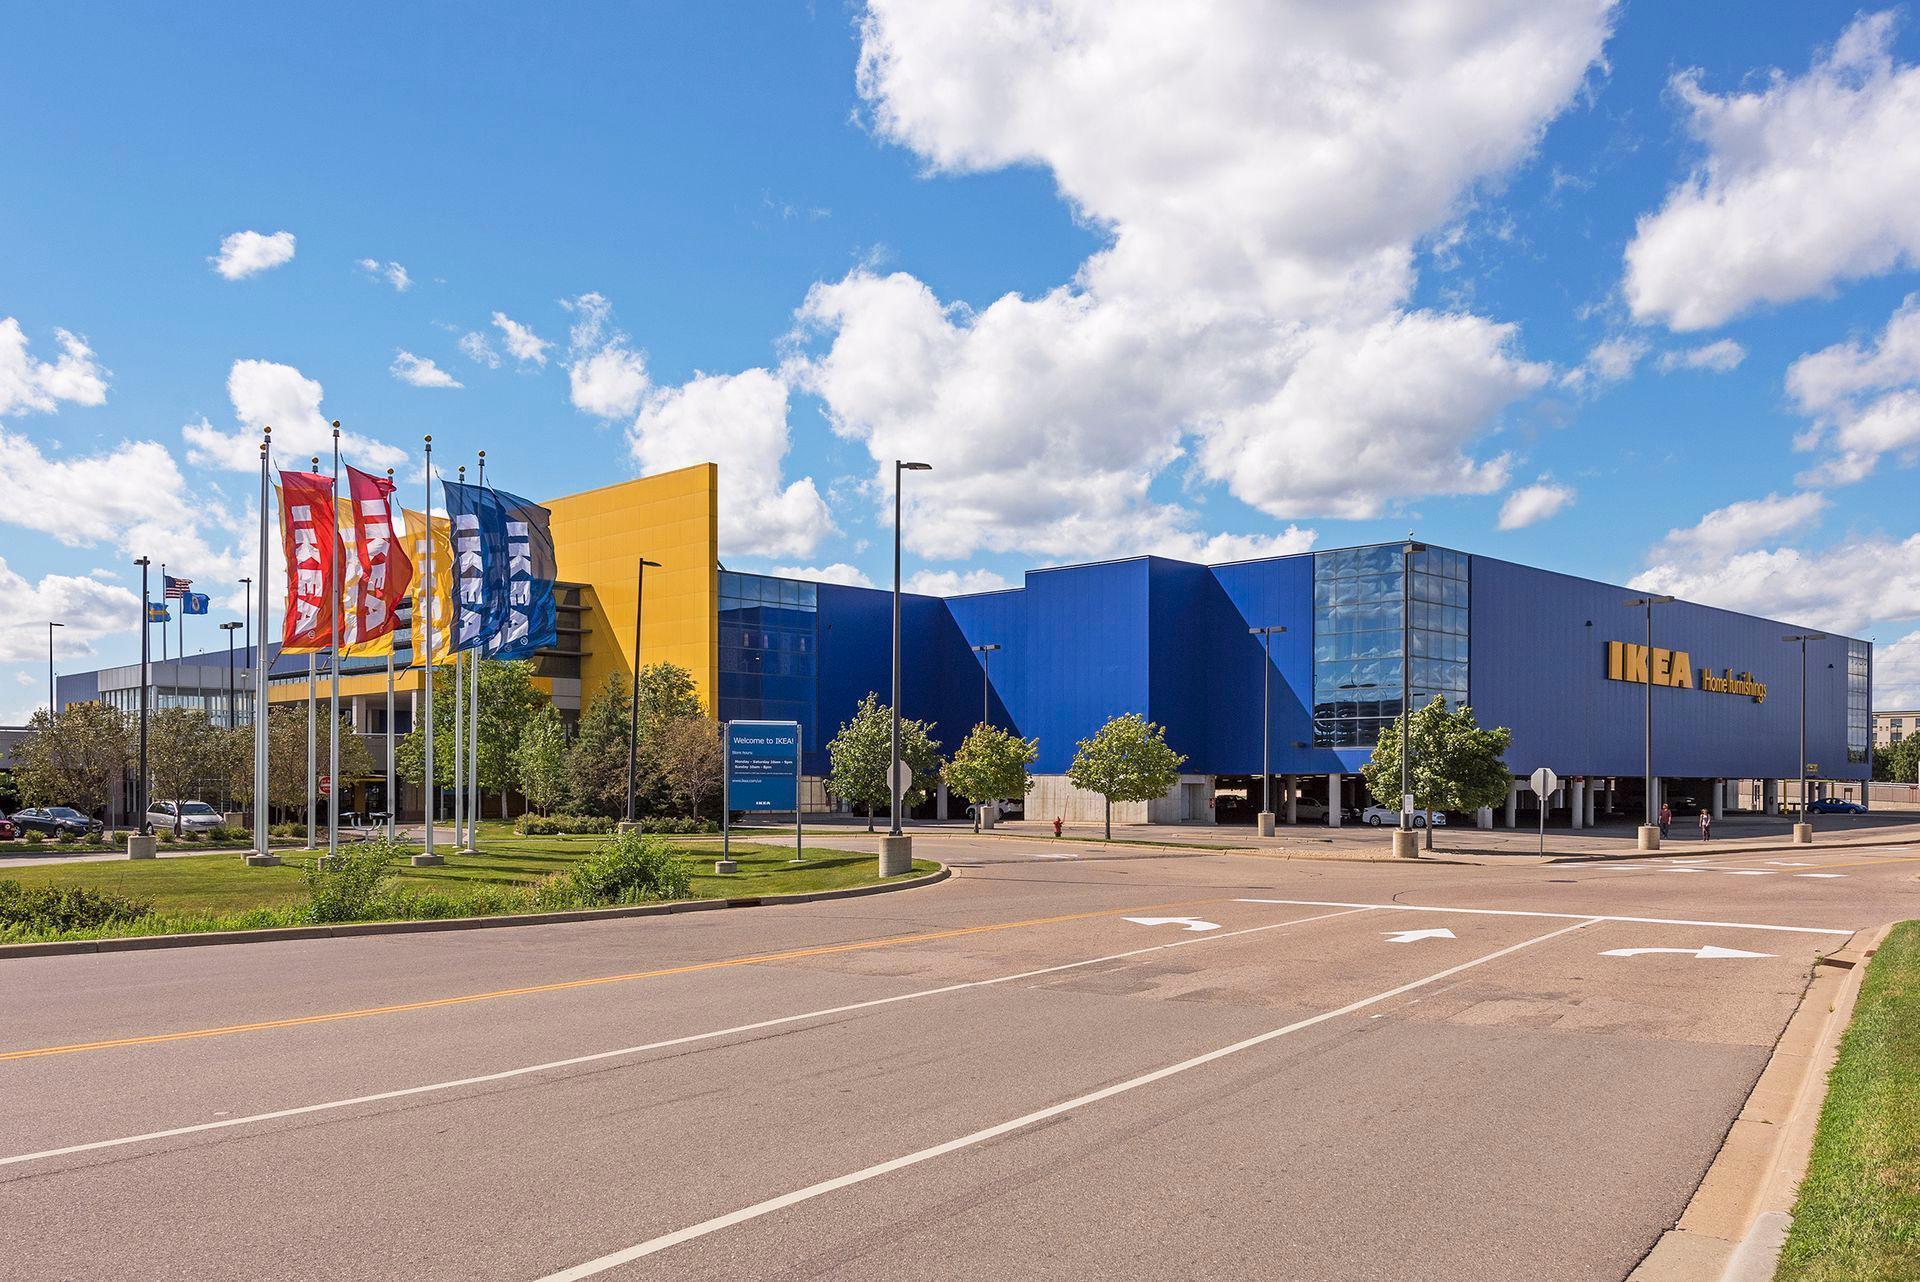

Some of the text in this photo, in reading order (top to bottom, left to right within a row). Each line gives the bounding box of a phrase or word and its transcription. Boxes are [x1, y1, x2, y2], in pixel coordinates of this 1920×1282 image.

[291, 505, 323, 636] IKEA
[360, 499, 391, 632] IKEA
[456, 514, 484, 644] IKEA
[506, 522, 532, 644] IKEA
[1608, 640, 1694, 689] IKEA
[1701, 667, 1767, 704] Home furnishings
[733, 737, 764, 745] Welcome
[775, 737, 794, 745] IKEA!
